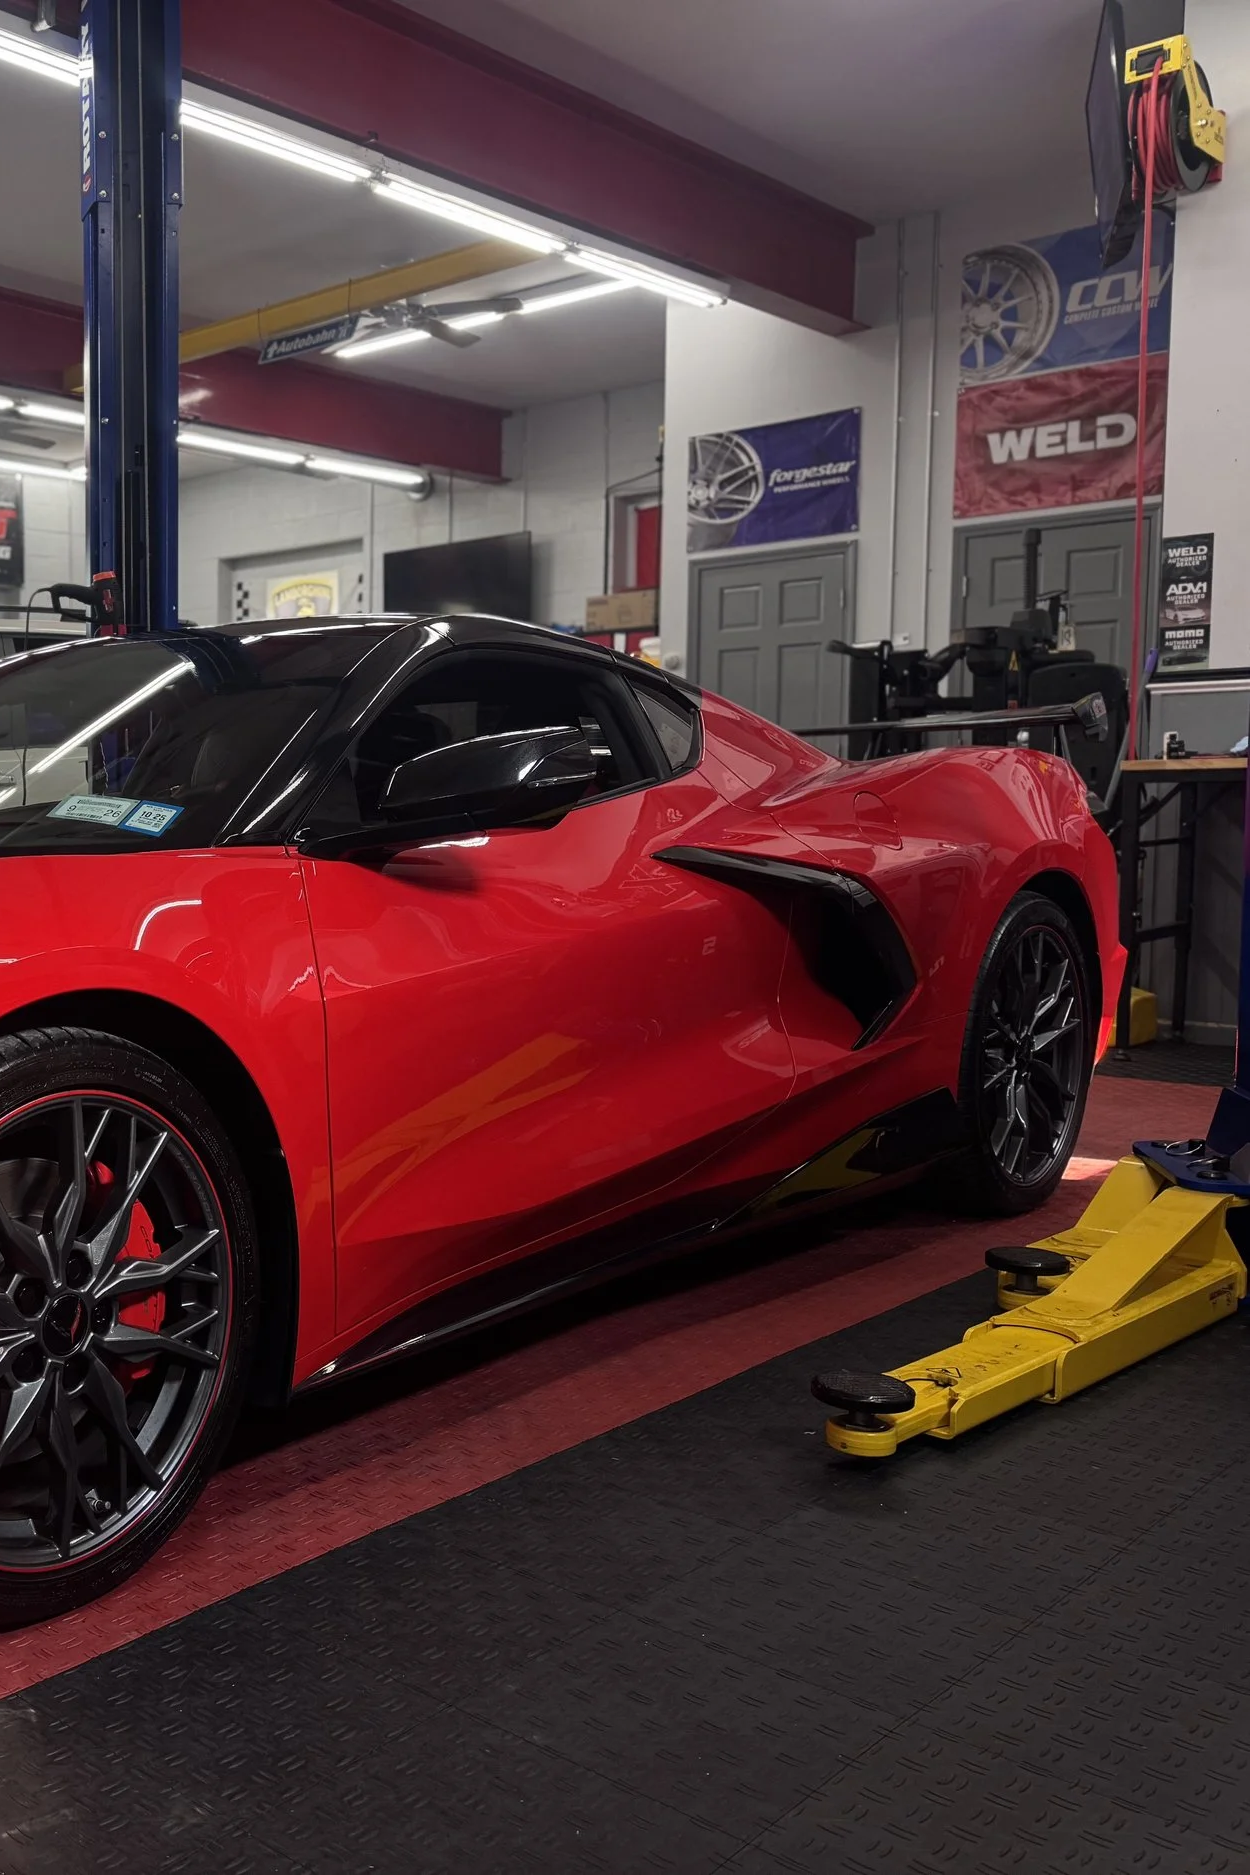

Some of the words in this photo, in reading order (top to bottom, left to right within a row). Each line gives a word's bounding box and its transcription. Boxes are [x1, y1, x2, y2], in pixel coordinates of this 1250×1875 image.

[1065, 263, 1173, 313] CCW
[276, 329, 336, 354] Autobahn
[986, 412, 1137, 465] WELD
[768, 460, 856, 487] forgestar
[1167, 545, 1208, 558] WELD
[1167, 555, 1207, 564] AUTHORIZED
[1166, 581, 1207, 596] ADV.1
[1166, 593, 1205, 602] AUTHORIZED
[1164, 639, 1203, 648] AUTHORIZED
[66, 804, 77, 812] 9
[103, 808, 122, 818] 26
[141, 810, 152, 818] 10
[152, 813, 167, 821] 25
